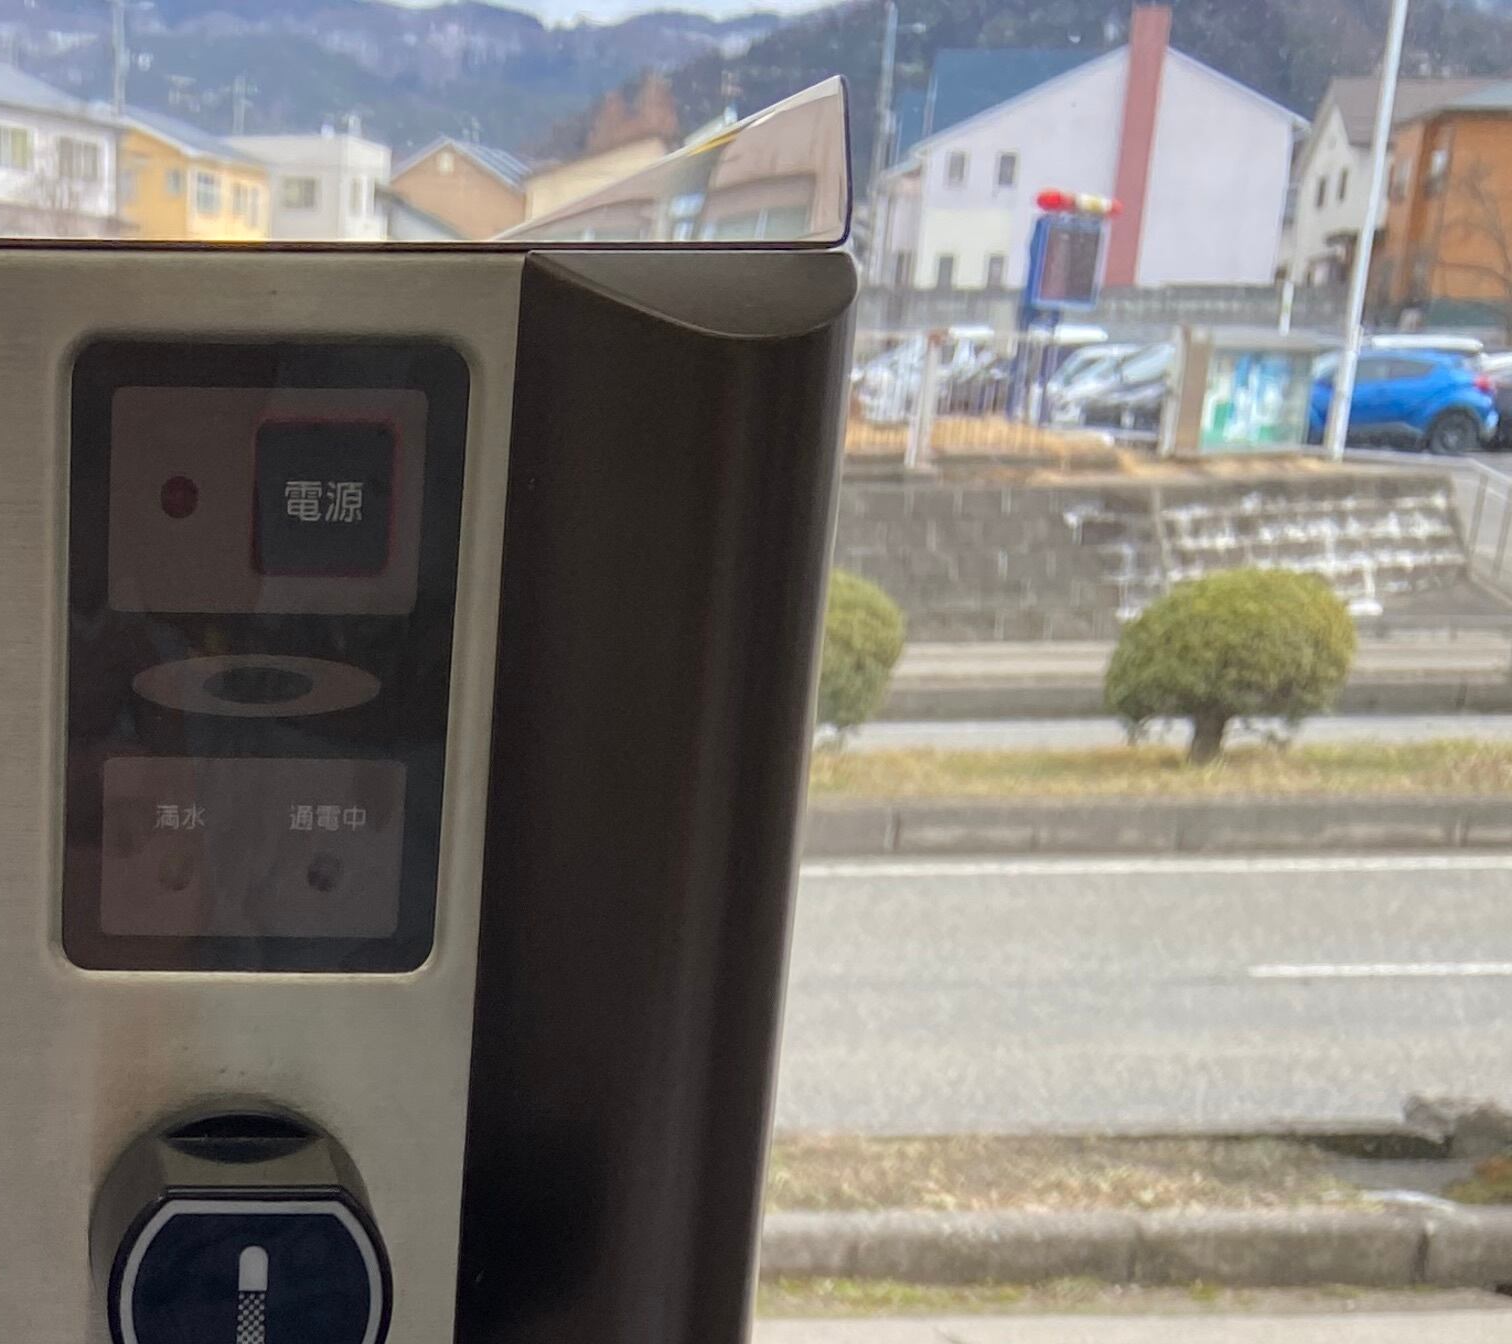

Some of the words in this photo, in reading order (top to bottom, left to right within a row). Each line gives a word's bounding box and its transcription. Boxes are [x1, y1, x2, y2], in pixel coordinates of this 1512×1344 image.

[284, 481, 364, 522] 電源
[154, 804, 205, 832] 満水
[289, 804, 367, 832] 通電中
